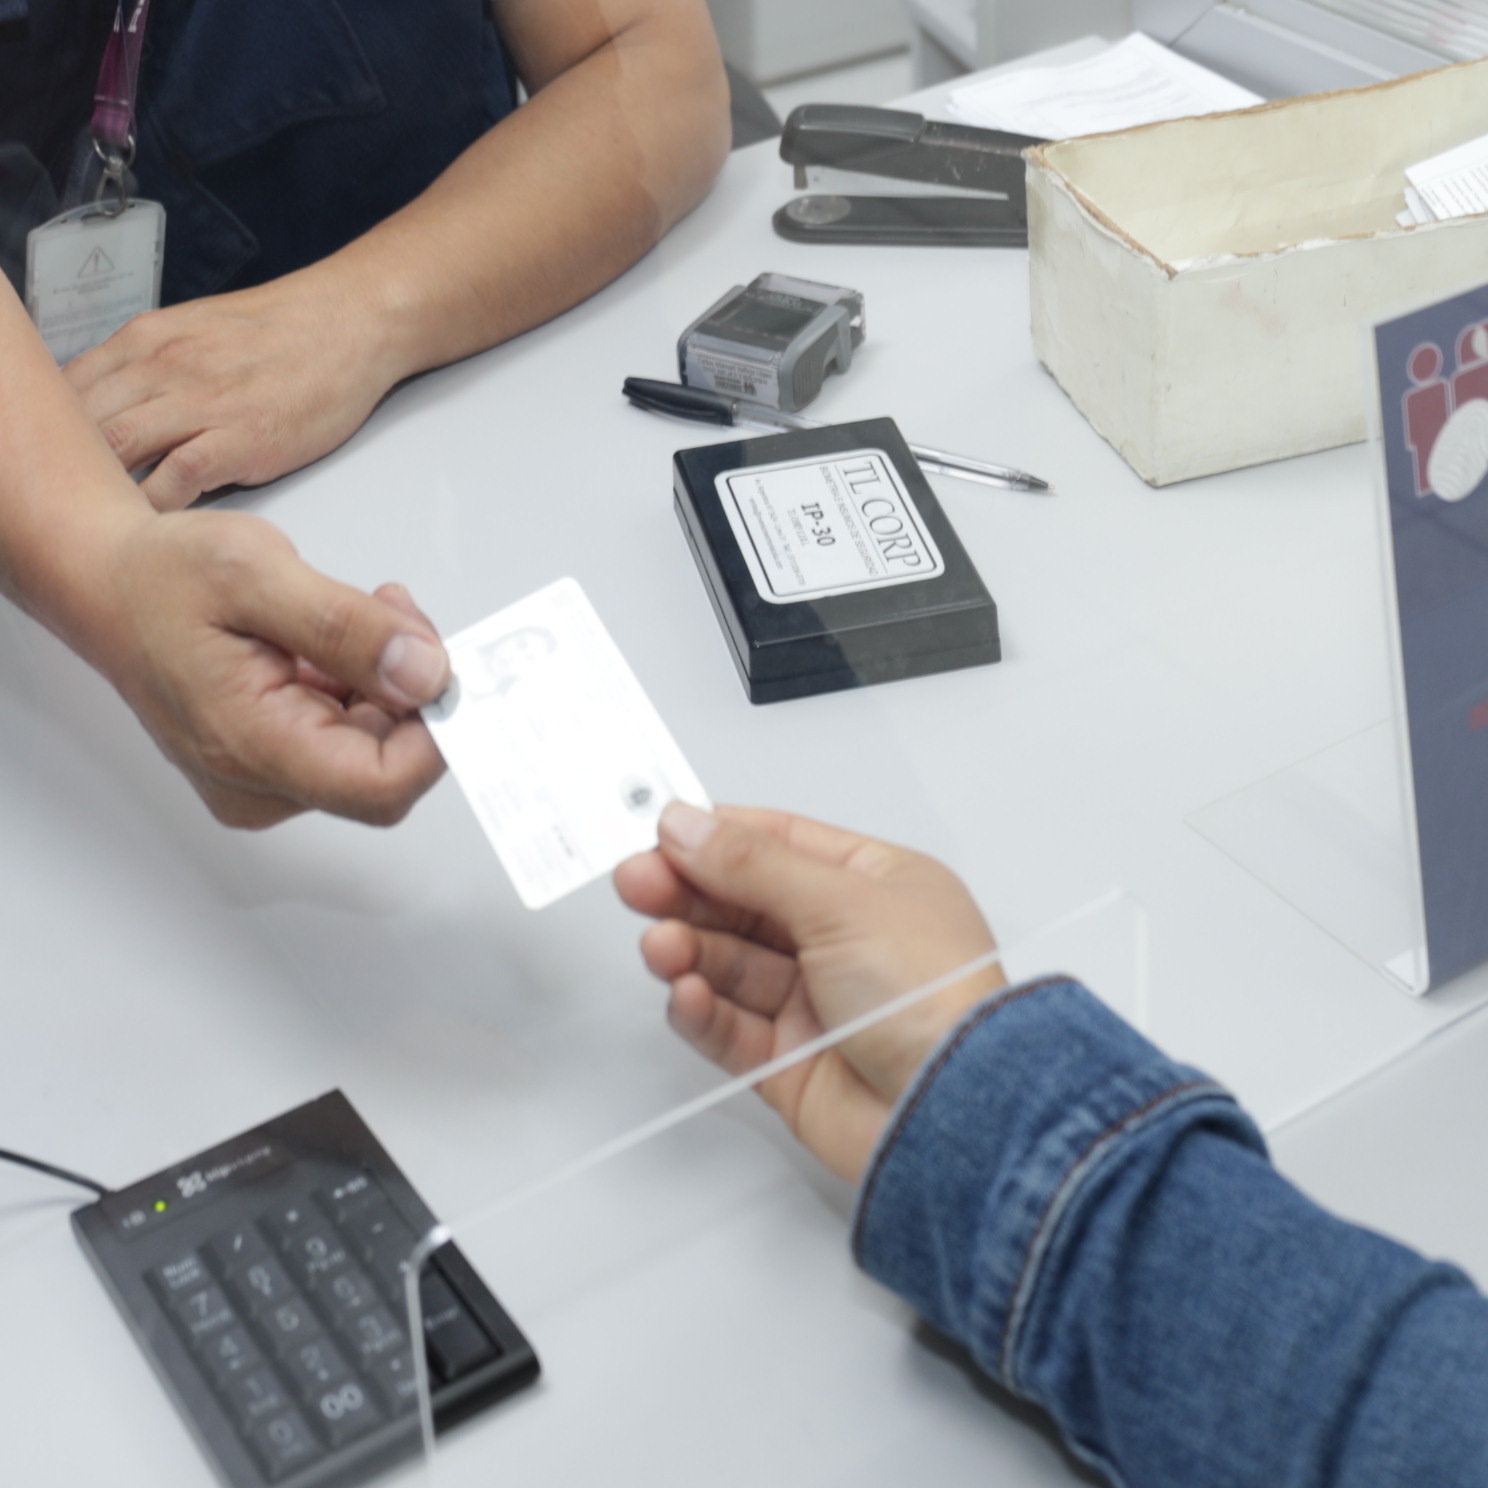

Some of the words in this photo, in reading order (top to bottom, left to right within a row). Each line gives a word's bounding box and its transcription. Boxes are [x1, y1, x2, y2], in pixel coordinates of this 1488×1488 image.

[843, 461, 881, 495] TL
[801, 503, 836, 547] IP-30
[861, 497, 922, 569] CORP
[189, 1293, 214, 1315] 7
[319, 1383, 363, 1419] 00
